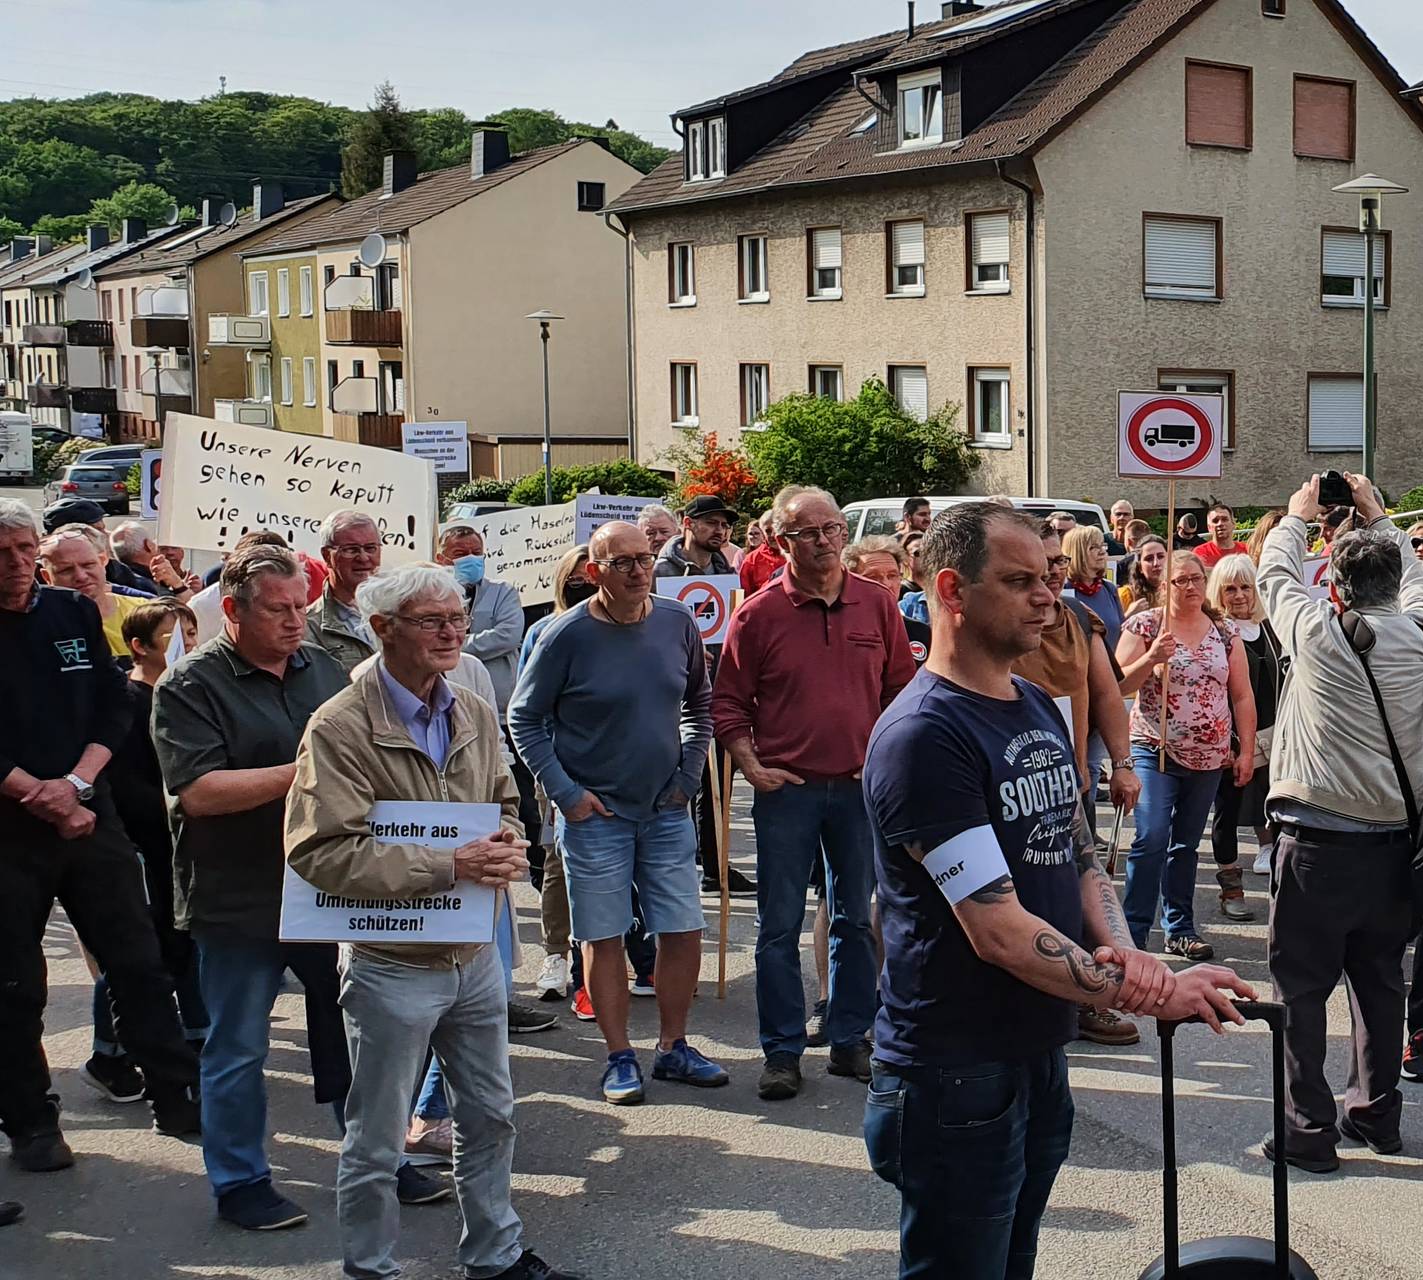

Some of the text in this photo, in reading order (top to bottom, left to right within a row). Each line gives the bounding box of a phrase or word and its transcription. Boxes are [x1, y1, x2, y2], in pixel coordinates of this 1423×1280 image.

[427, 406, 439, 416] 30
[200, 431, 362, 474] Unsere Nerven
[199, 464, 266, 486] gehen
[286, 477, 312, 493] so
[197, 498, 240, 522] wie
[431, 824, 459, 838] aus
[348, 915, 425, 931] schützen!
